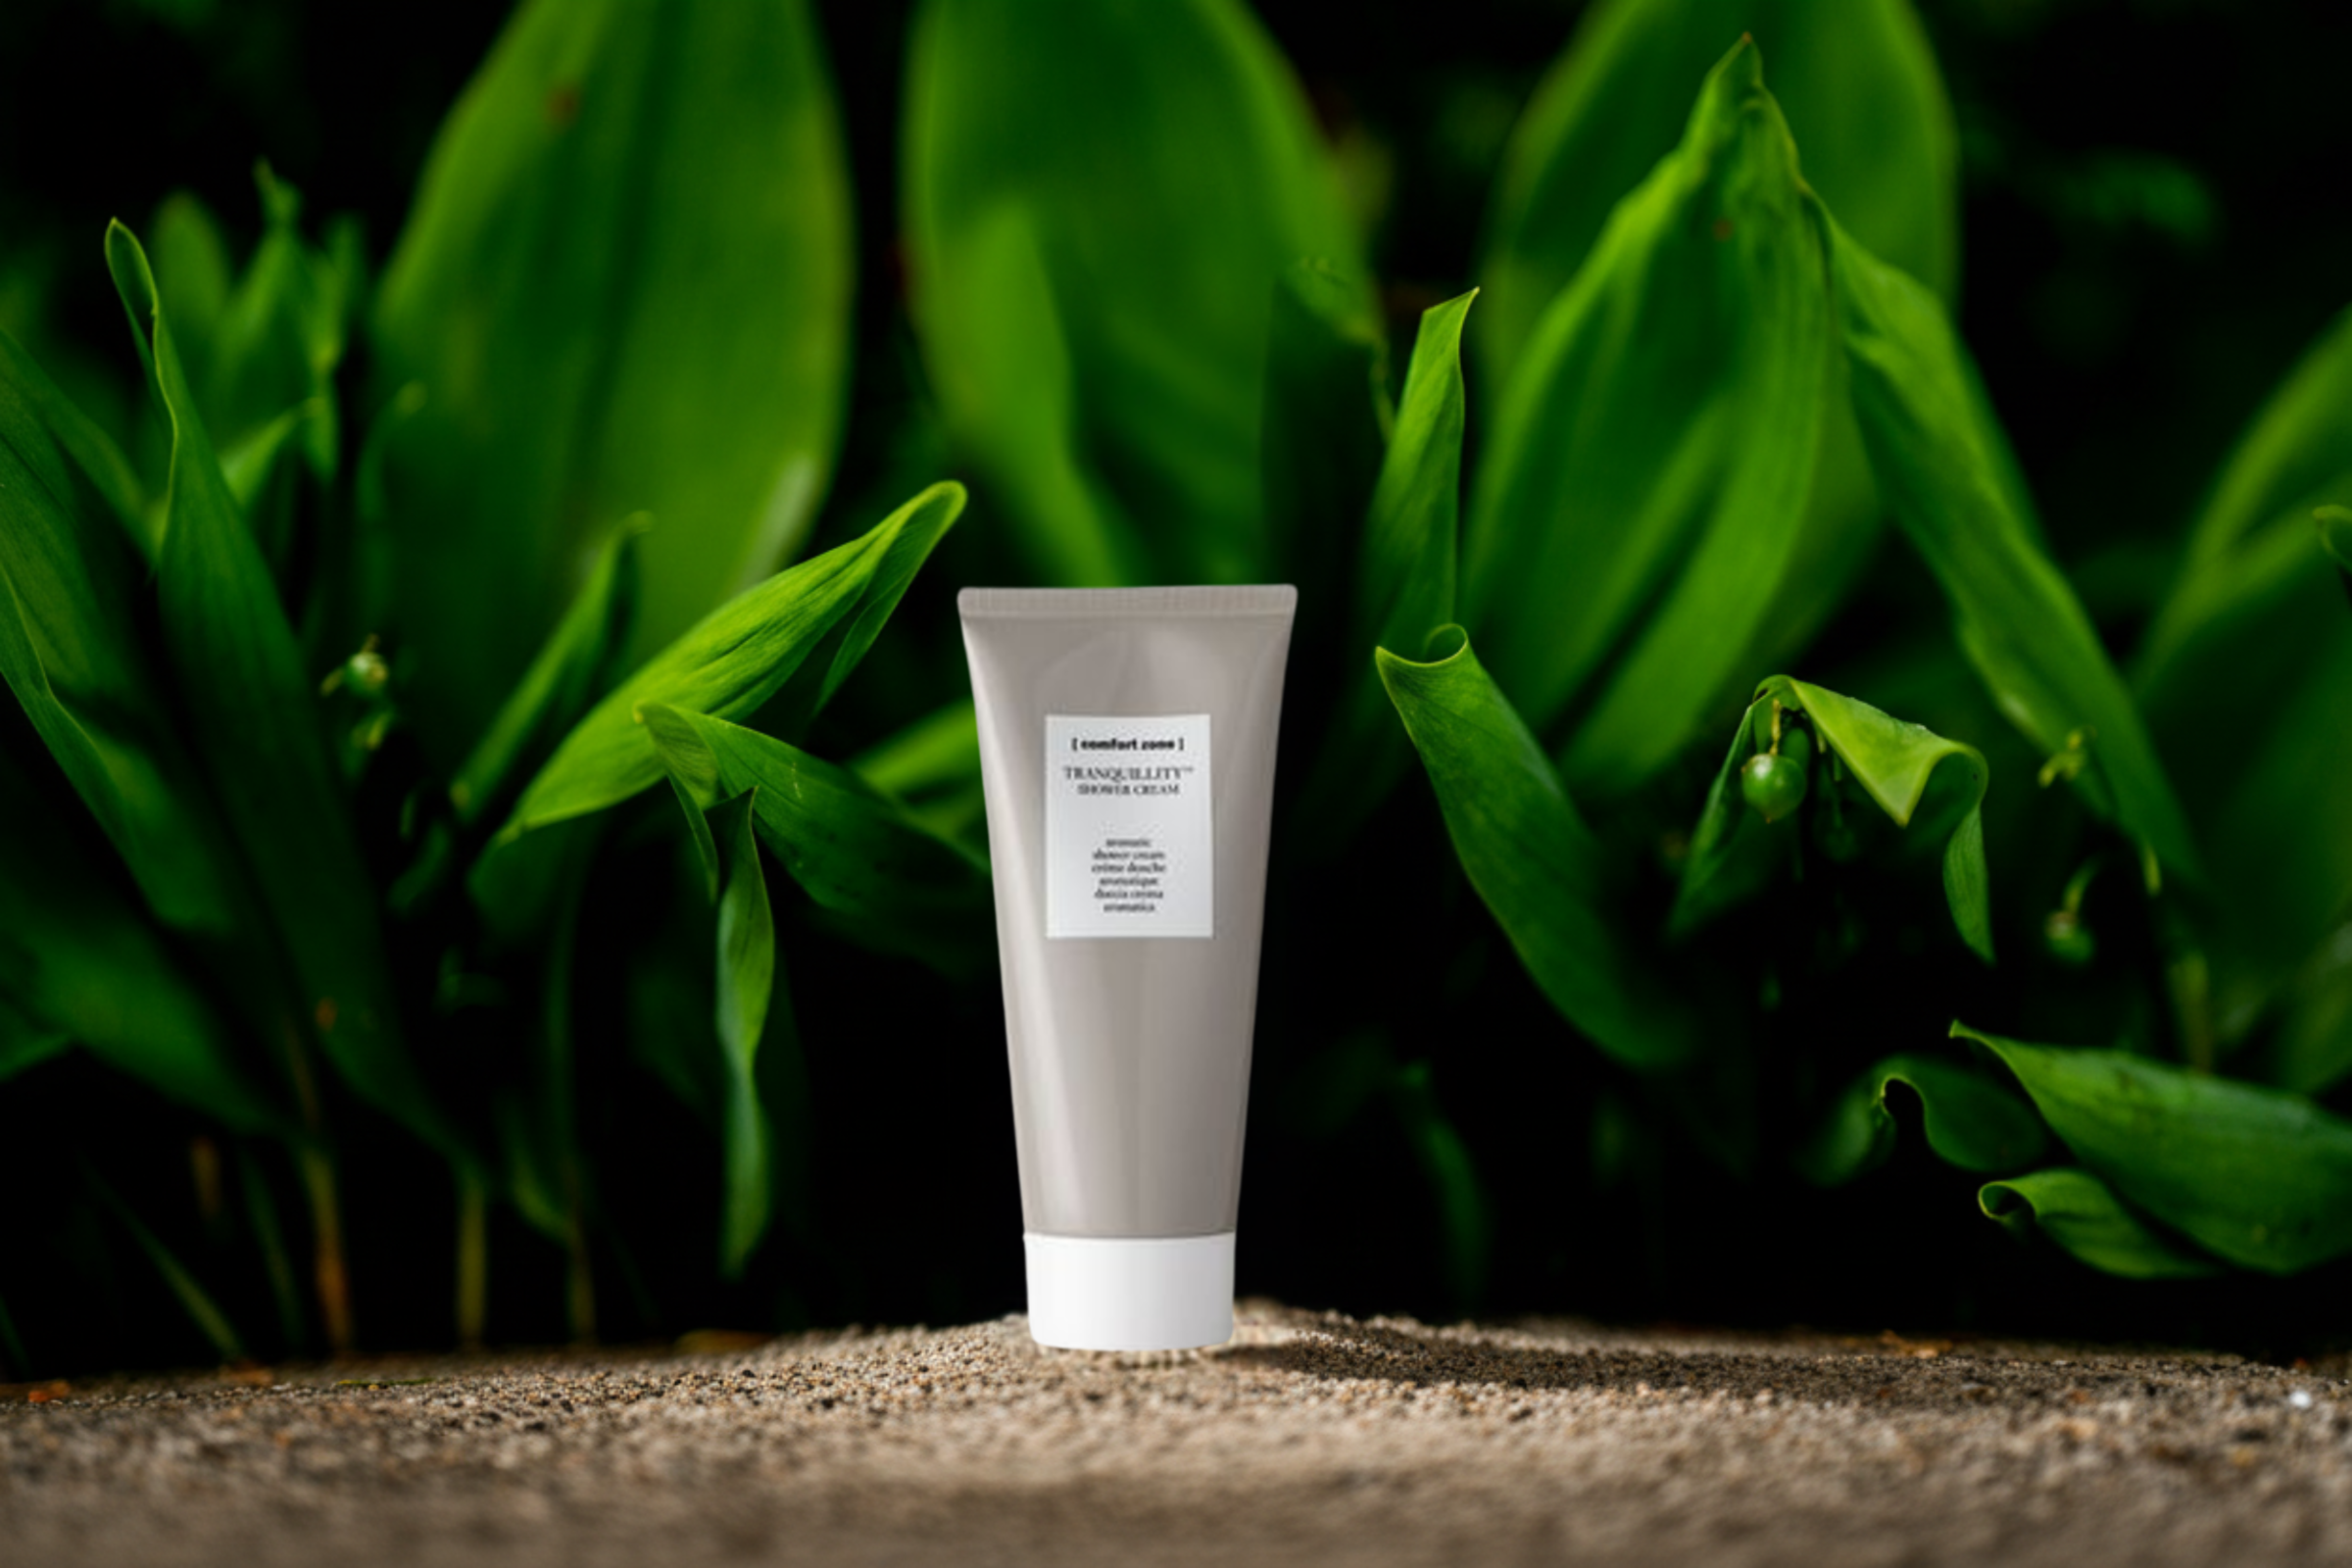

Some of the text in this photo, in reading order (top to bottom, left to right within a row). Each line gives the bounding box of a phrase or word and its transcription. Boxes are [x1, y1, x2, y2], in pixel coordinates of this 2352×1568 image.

[1080, 737, 1138, 751] comfort
[1141, 739, 1175, 751] zone
[1078, 784, 1180, 796] SHOWER CREAM
